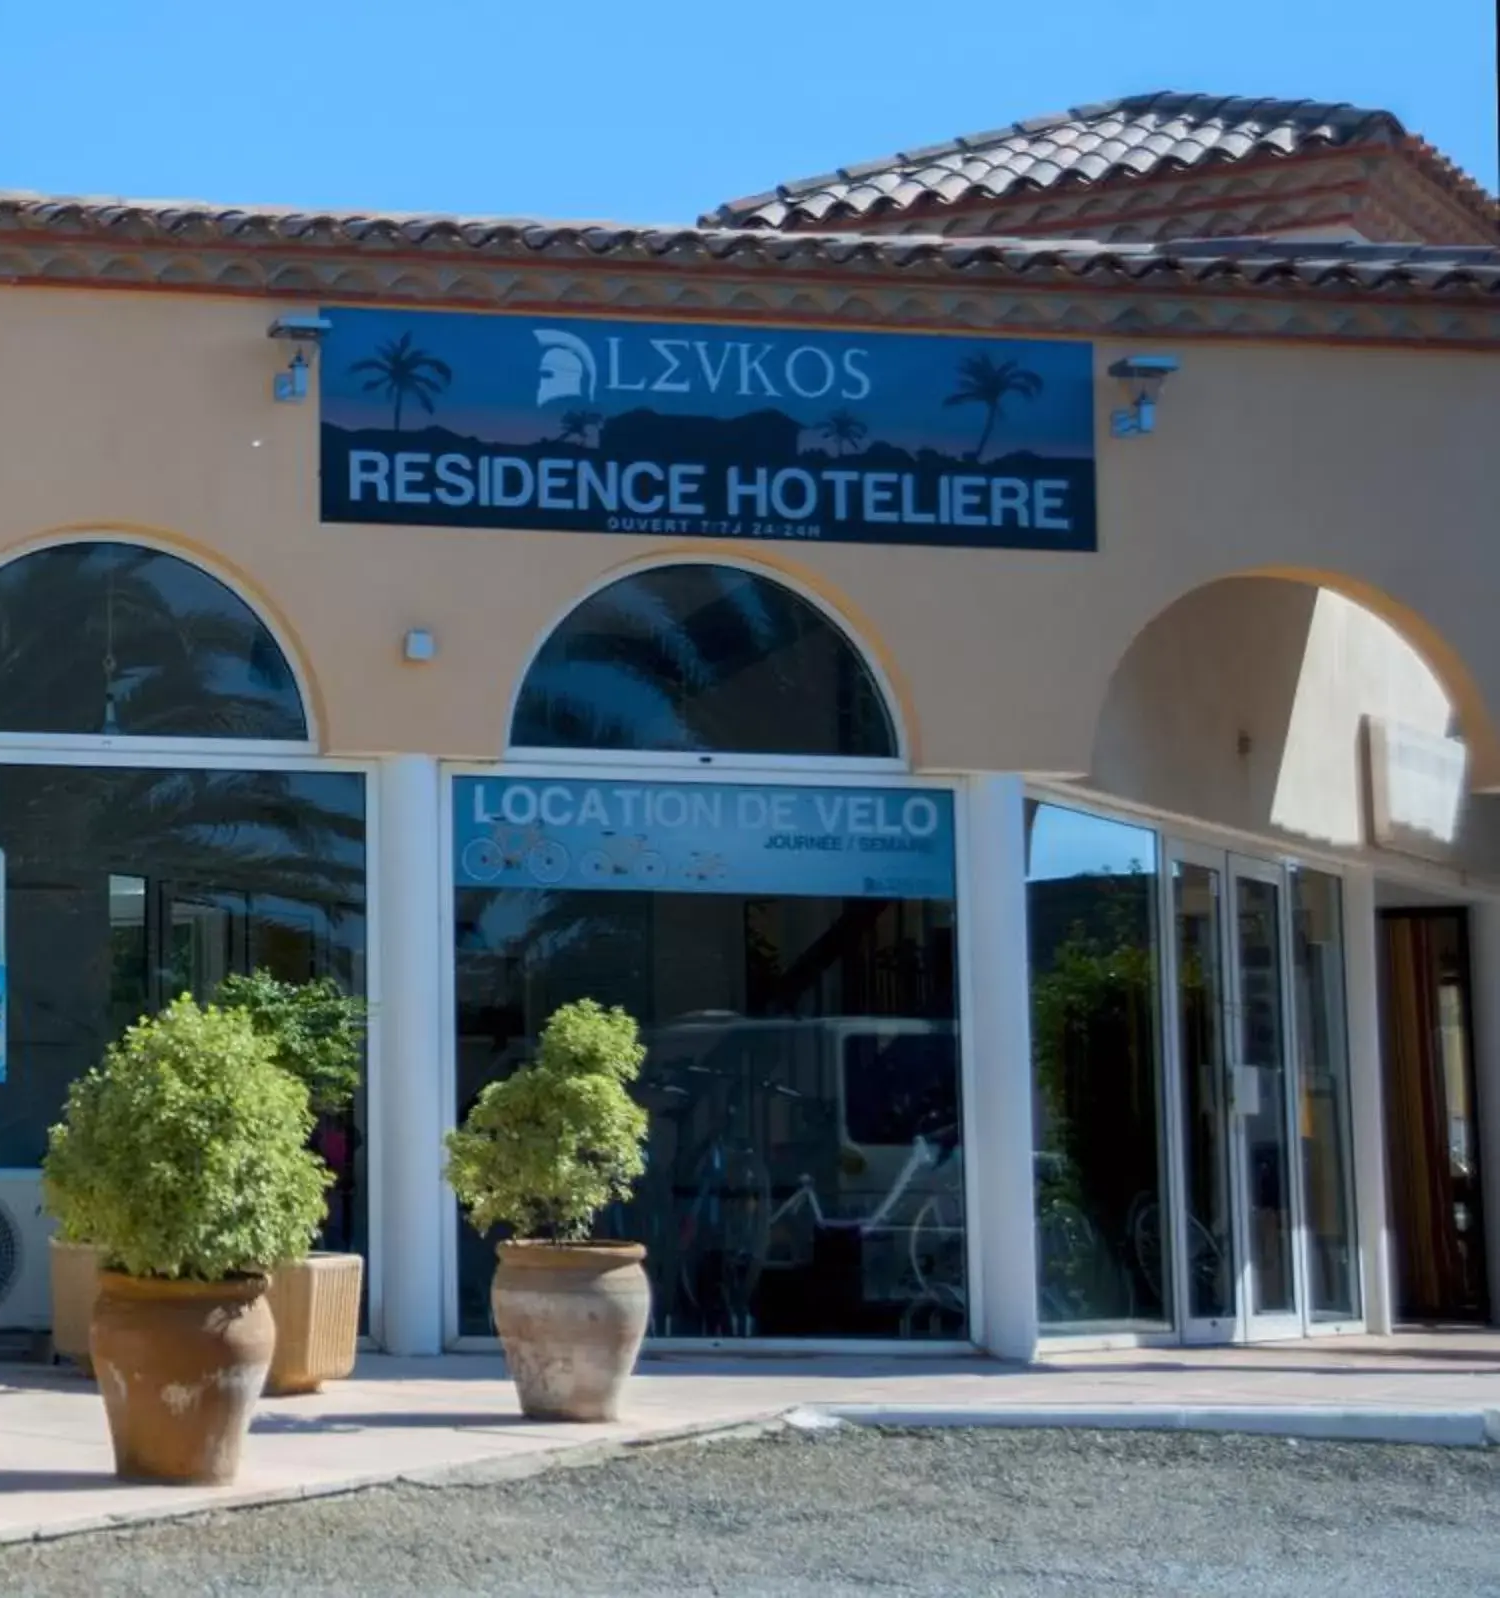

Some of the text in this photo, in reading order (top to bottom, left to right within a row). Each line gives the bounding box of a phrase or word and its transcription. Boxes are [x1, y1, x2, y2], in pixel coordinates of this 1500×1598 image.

[349, 449, 1071, 530] RESIDENCE HOTELIERE
[607, 515, 691, 534] OUVERT
[473, 784, 939, 837] LOCATION DE VELO
